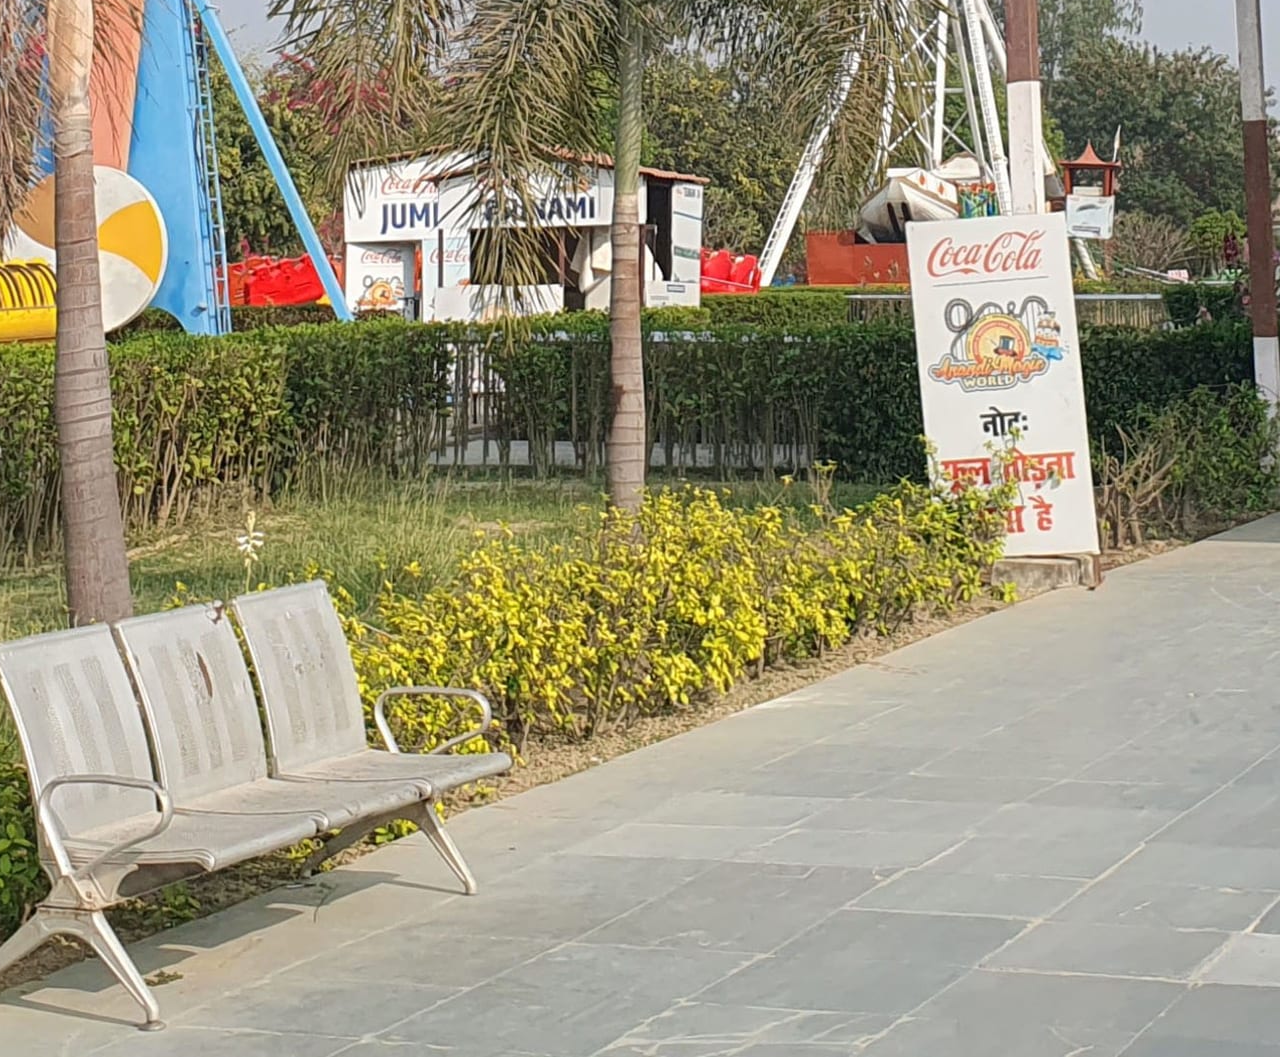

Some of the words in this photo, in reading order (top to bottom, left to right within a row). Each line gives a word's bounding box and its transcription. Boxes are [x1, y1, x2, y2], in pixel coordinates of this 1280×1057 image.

[927, 230, 1046, 277] Coca-Cola
[963, 374, 1014, 389] WORLD
[1028, 494, 1053, 532] है
